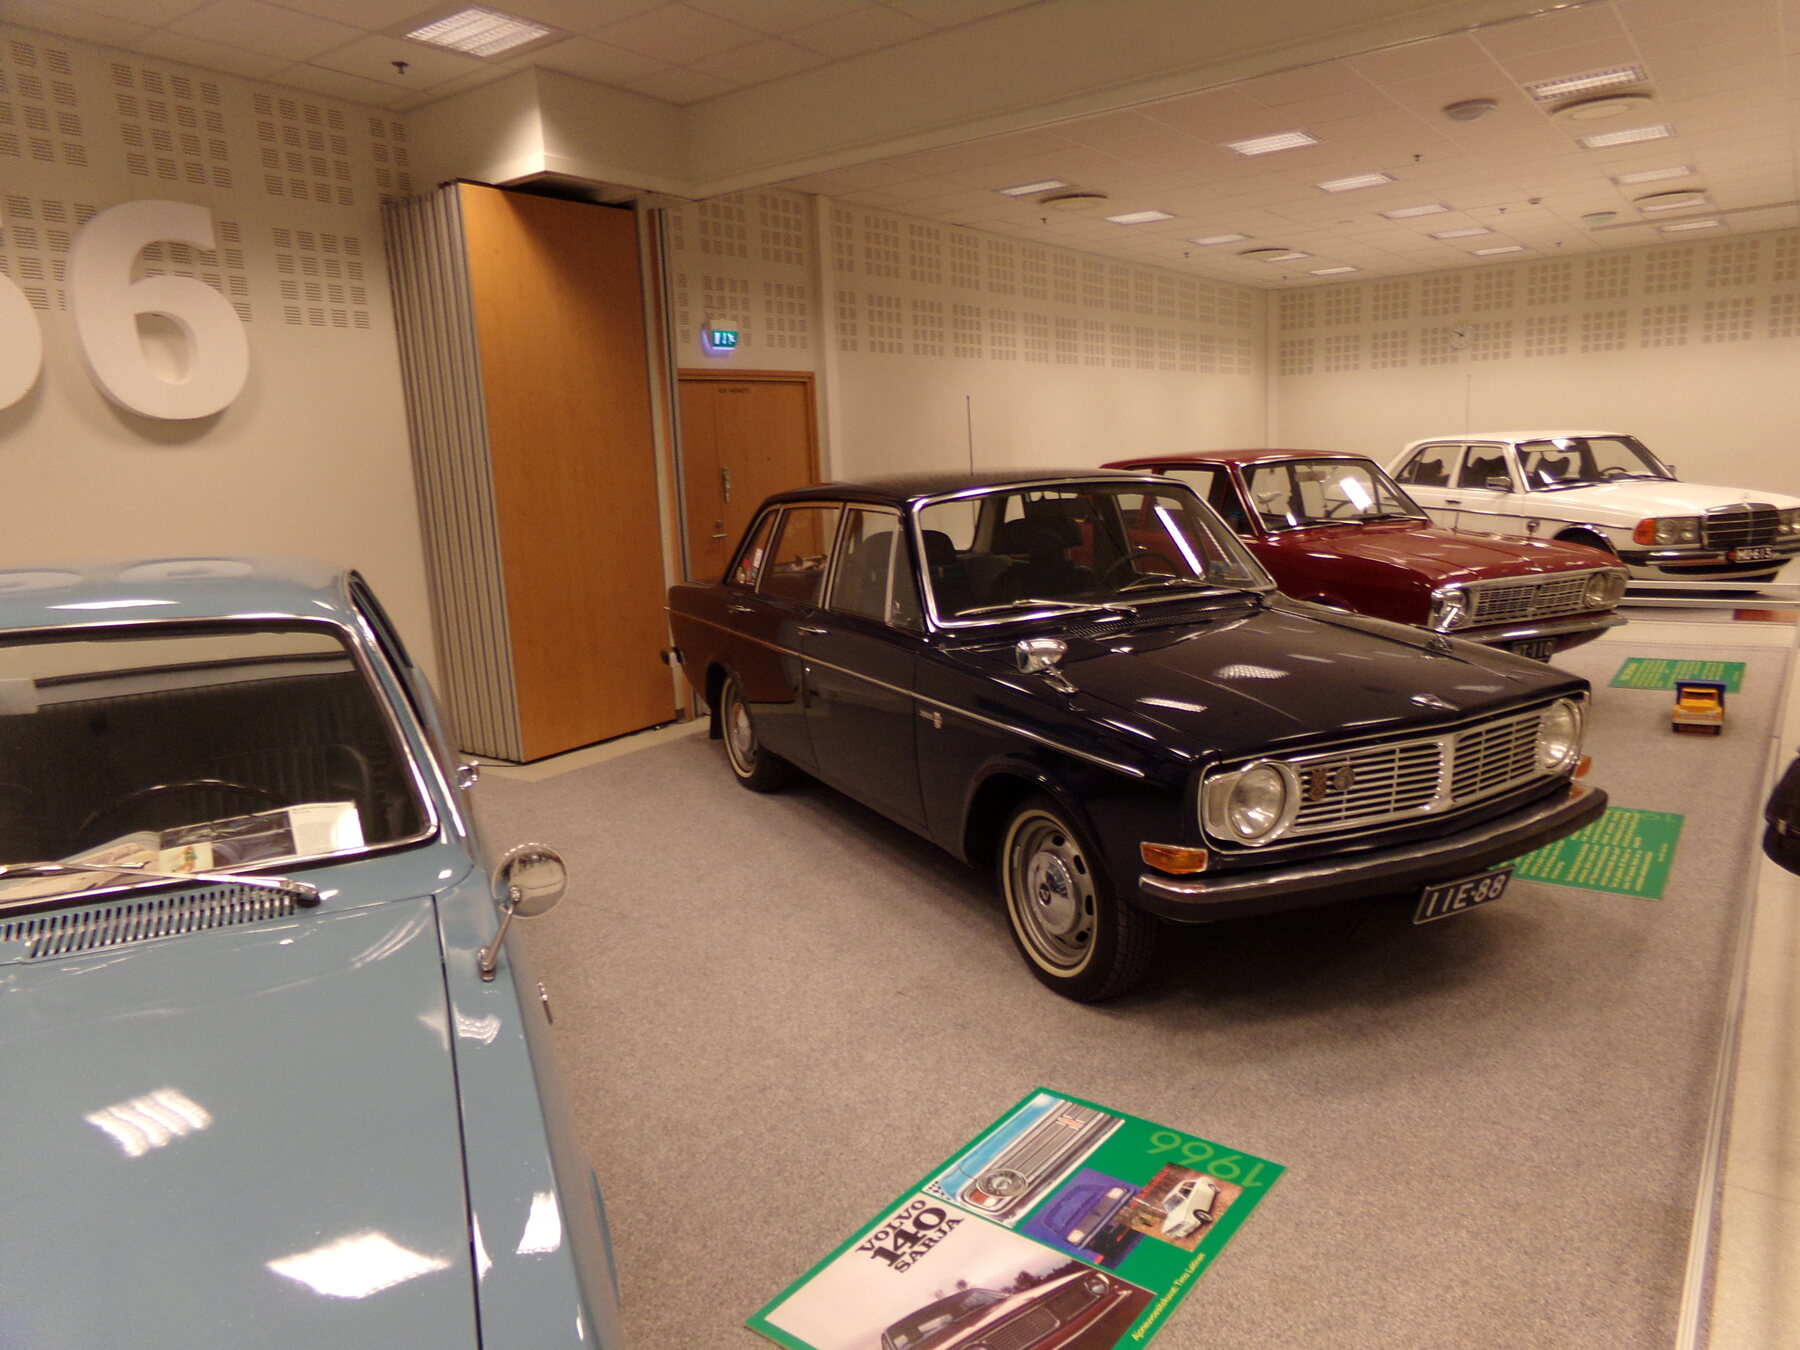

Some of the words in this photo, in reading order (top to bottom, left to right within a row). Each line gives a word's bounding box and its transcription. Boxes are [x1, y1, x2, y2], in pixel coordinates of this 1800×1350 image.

[1146, 1130, 1265, 1188] 1966
[855, 1199, 927, 1253] VOLVO
[869, 1206, 947, 1268] 140
[894, 1217, 965, 1274] SARJA
